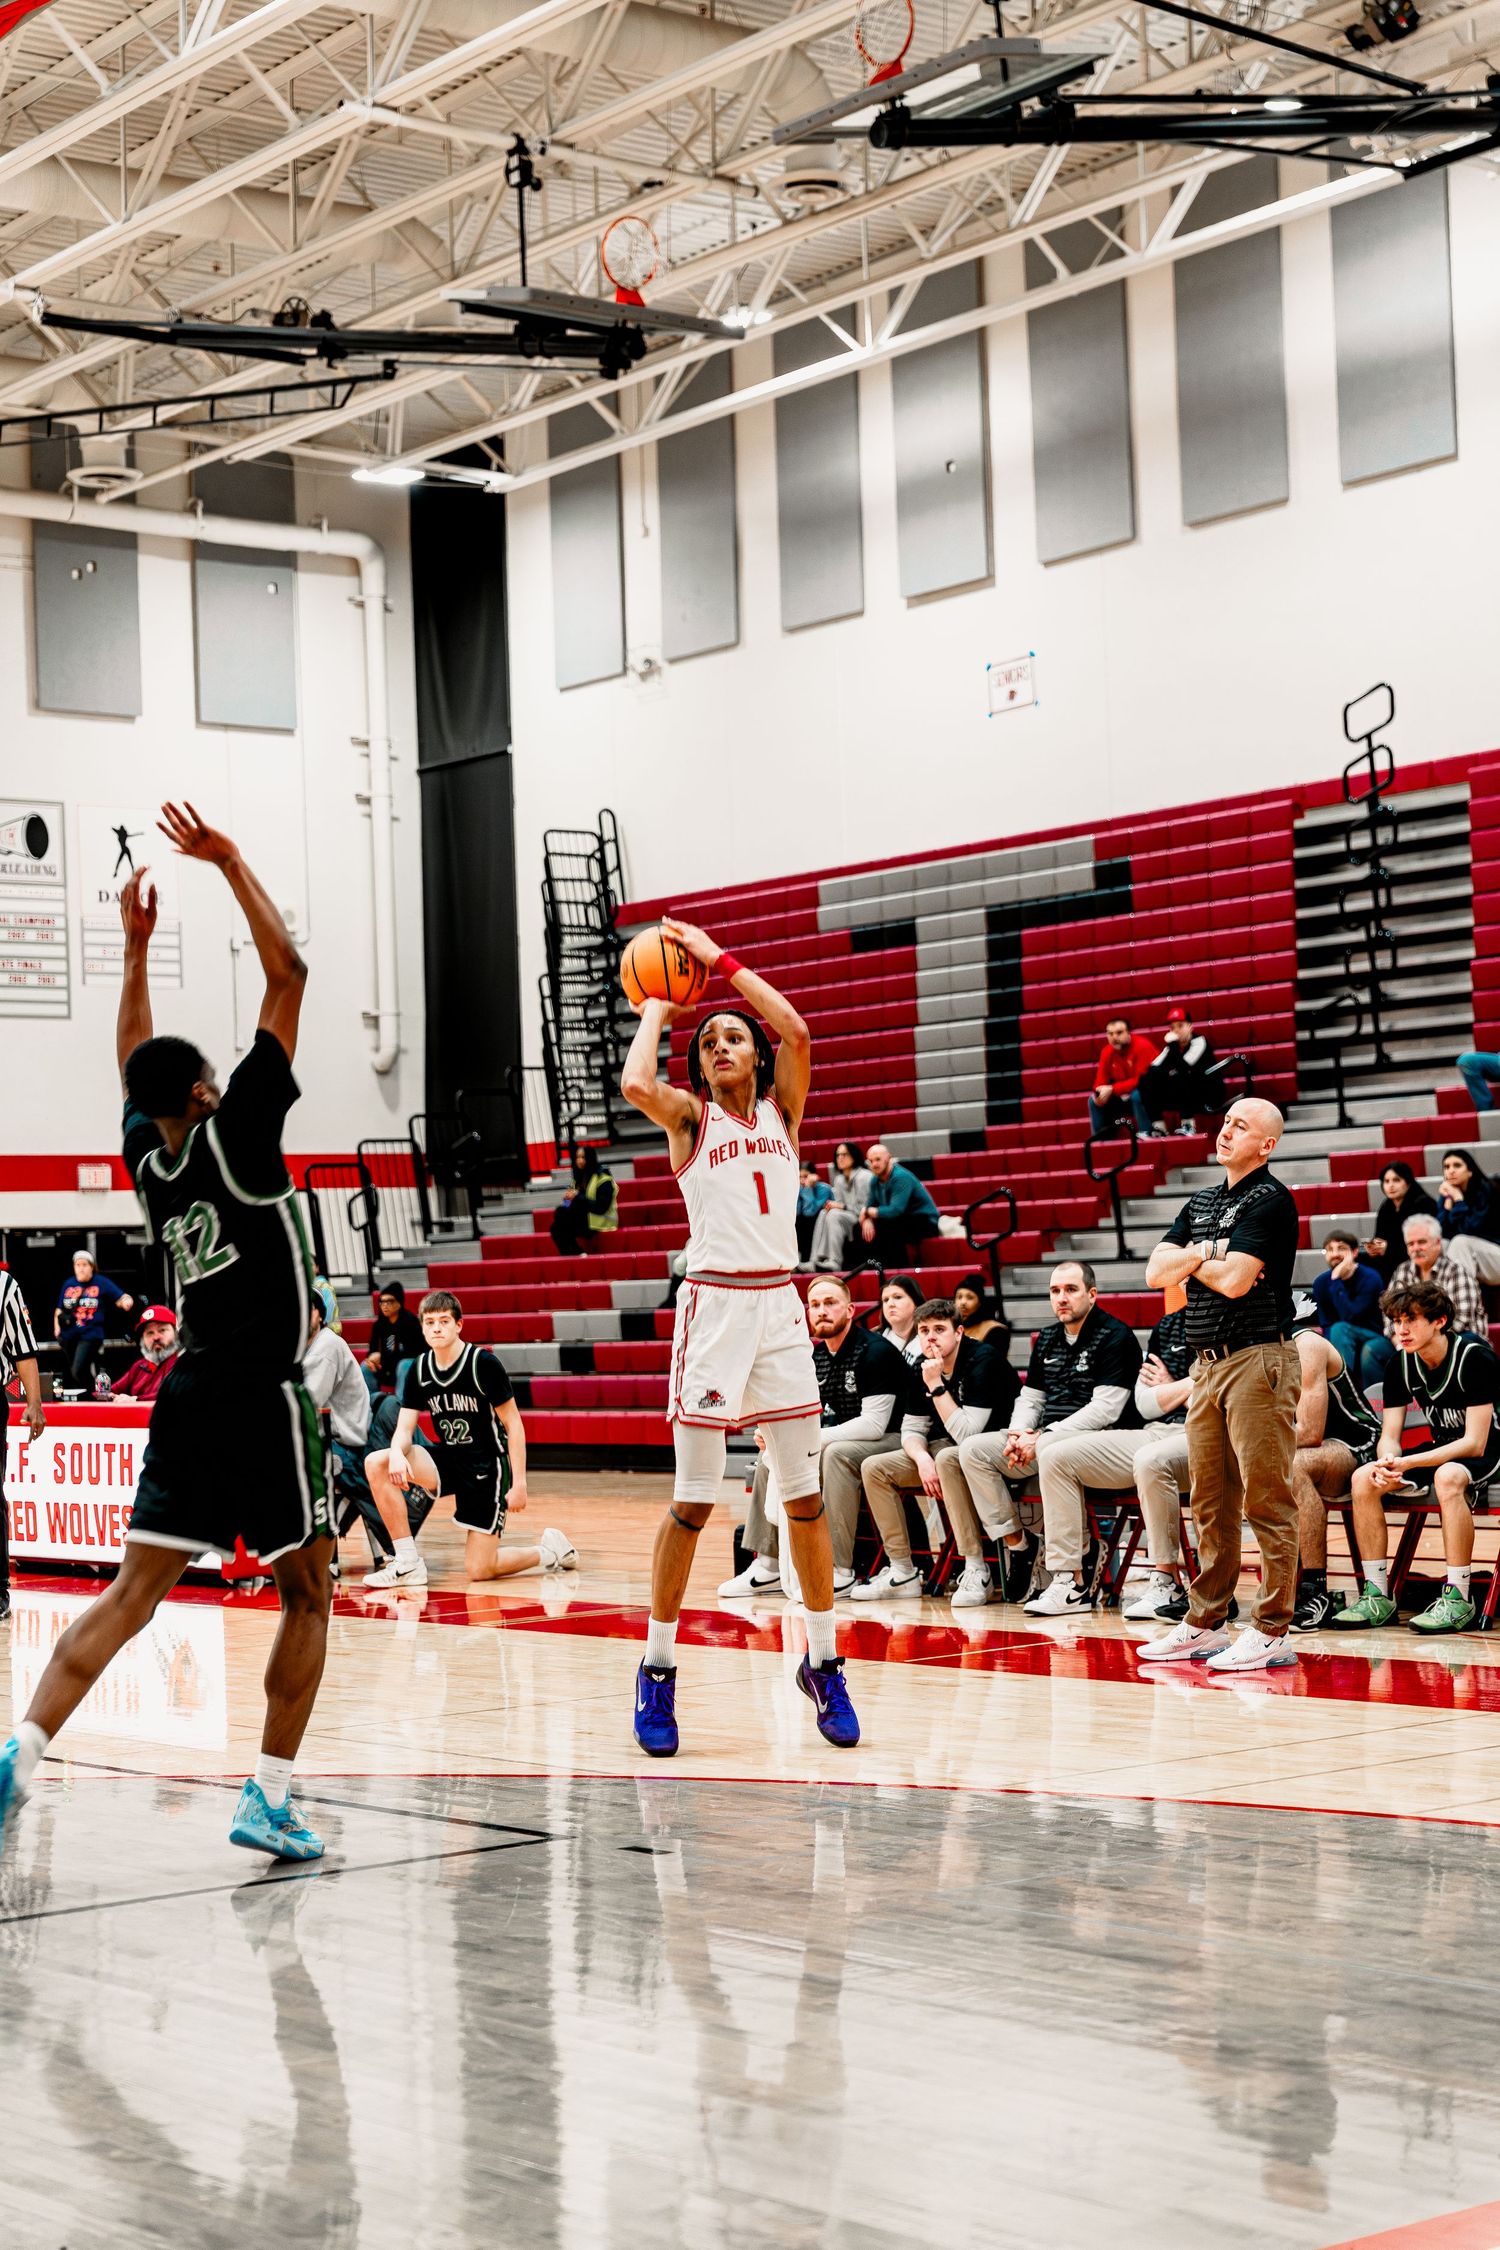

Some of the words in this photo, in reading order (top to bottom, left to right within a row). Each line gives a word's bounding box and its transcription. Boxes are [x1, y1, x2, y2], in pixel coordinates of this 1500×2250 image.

[709, 1140, 738, 1169] RED
[753, 1171, 769, 1214] 1
[444, 1393, 479, 1412] LAWN
[440, 1418, 473, 1445] 22
[5, 1442, 35, 1483] .F.
[53, 1442, 133, 1486] SOUTH
[46, 1501, 134, 1547] WOLVES
